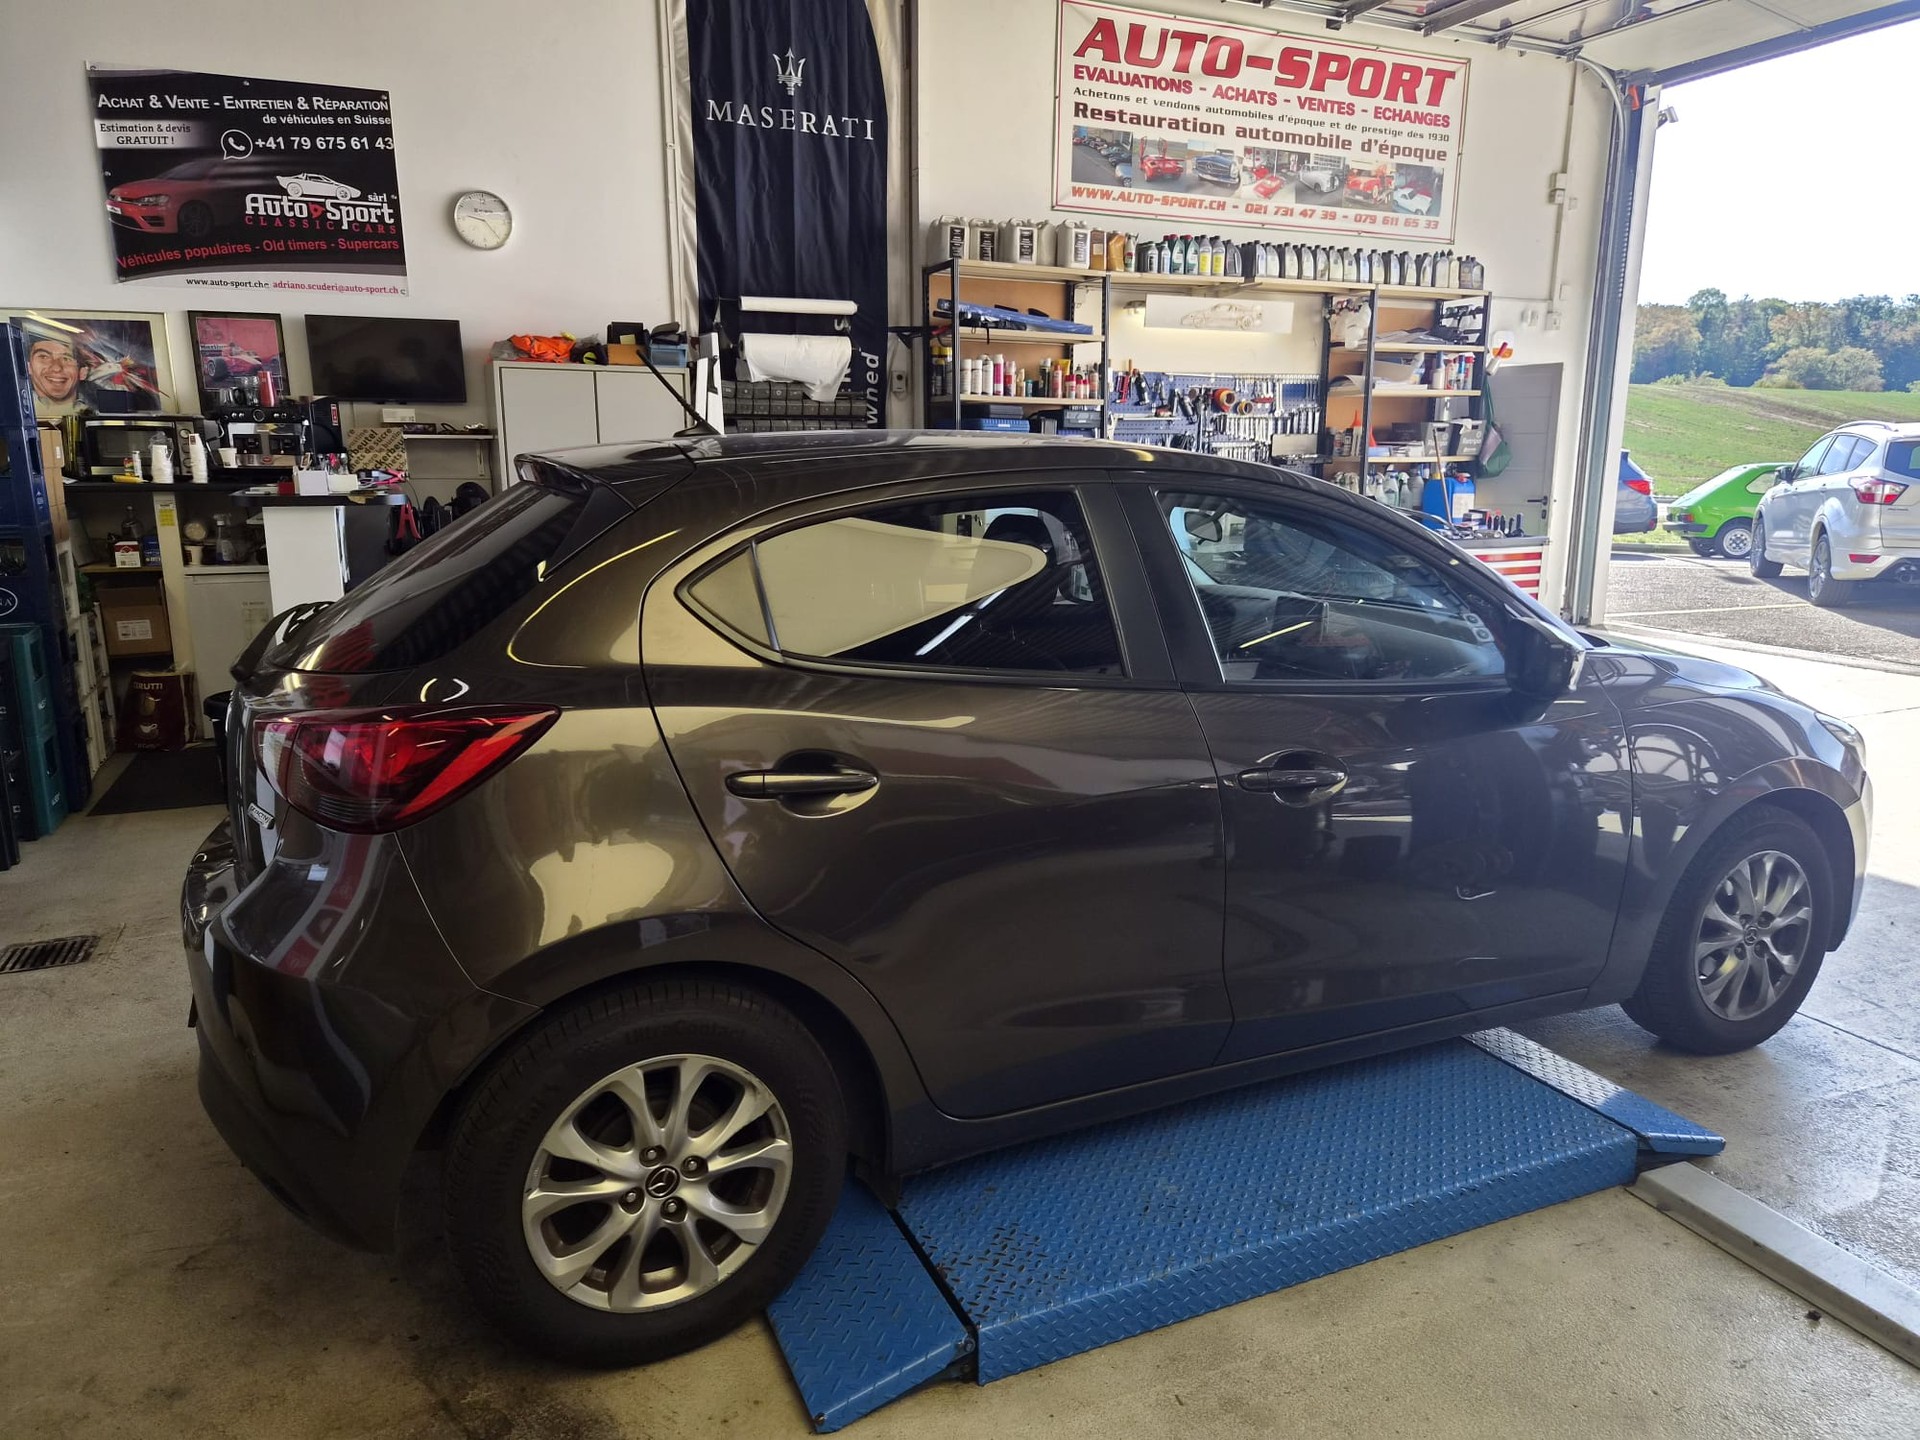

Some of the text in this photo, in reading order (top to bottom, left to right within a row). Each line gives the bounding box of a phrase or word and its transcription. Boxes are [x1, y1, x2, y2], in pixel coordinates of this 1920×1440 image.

[1073, 17, 1457, 107] AUTO-SPORT
[149, 94, 163, 109] &
[297, 96, 310, 110] &
[1073, 64, 1193, 94] EVALUATIONS
[1212, 84, 1278, 106] ACHATS
[1297, 95, 1356, 116] VENTES
[1373, 106, 1451, 128] ECHANGES
[100, 123, 191, 133] Estimation & devis
[262, 114, 392, 125] de véhicules en Suisse
[706, 99, 875, 140] MASERATI
[1073, 87, 1131, 103] Achetons
[1135, 96, 1148, 105] et
[1153, 98, 1201, 112] vendons
[1205, 105, 1274, 121] automobiles
[1278, 114, 1326, 128] d'époque
[1329, 120, 1341, 130] et
[1344, 122, 1357, 132] de
[1361, 125, 1403, 138] prestige
[1428, 133, 1450, 142] 1930
[116, 136, 169, 145] GRATUIT
[255, 136, 395, 150] +41 79 675 61 43
[1073, 101, 1447, 162] Restauration automobile d'époque
[245, 193, 395, 230] Auto Sport
[1071, 186, 1226, 211] WWW.AUTO-SPORT.CH
[1244, 203, 1268, 215] 021
[1273, 205, 1294, 217] 731
[1299, 207, 1317, 219] 47
[1320, 209, 1337, 221] 39
[1354, 212, 1377, 224] 079
[1382, 215, 1399, 226] 611
[1403, 217, 1419, 228] 65
[1424, 219, 1439, 230] 33
[245, 215, 397, 234] CLASSIC CARS
[117, 248, 182, 269] Véhicules
[184, 242, 252, 260] populaires
[262, 239, 284, 251] Old
[287, 238, 327, 250] timers
[338, 237, 399, 250] Supercars
[272, 280, 399, 295] adriano.scuderi@auto-sport.ch
